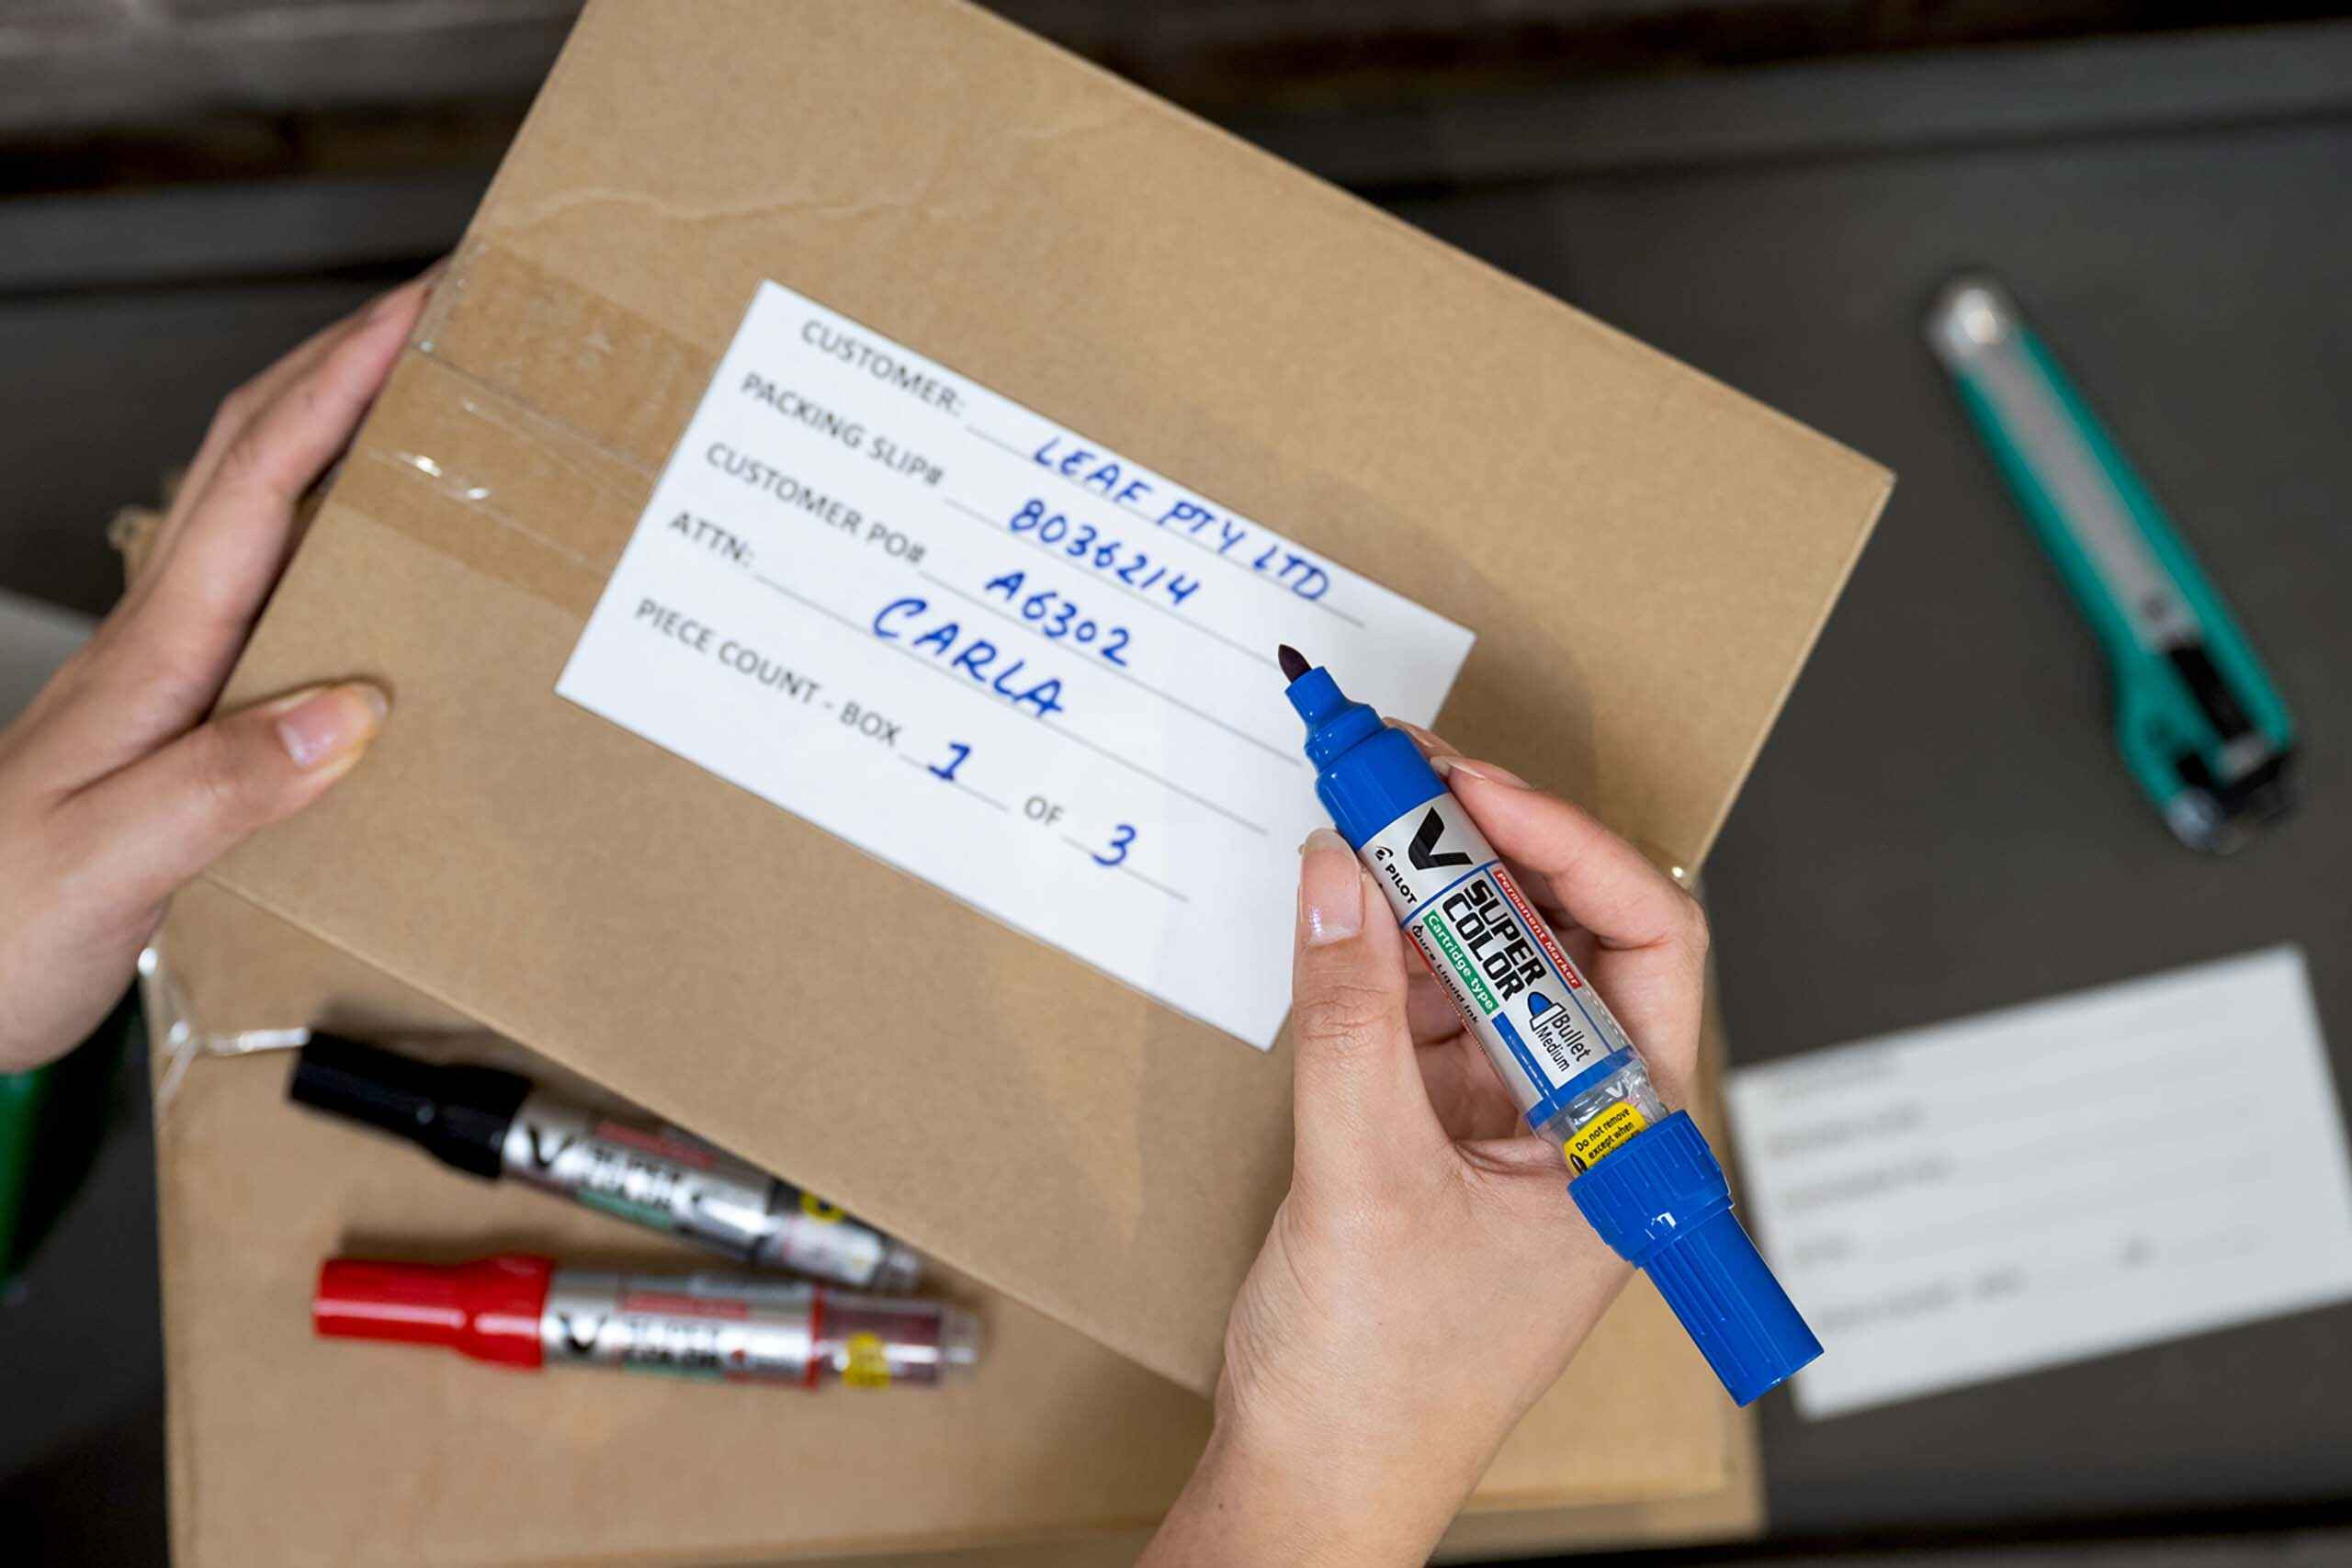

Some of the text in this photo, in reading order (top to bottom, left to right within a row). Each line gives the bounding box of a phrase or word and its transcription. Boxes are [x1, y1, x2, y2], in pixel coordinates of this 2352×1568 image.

[740, 371, 1200, 605] PACKING SLIP# 8036214
[801, 319, 1330, 602] CUSTOMER: LEAF PTY LTD
[705, 441, 1132, 667] CUSTOMER PO# A6302
[668, 510, 1064, 717] ATTN: CARLA
[635, 599, 712, 652] PIECE
[717, 640, 820, 706] COUNT
[840, 701, 902, 748] BOX
[927, 742, 972, 782] 1
[1023, 795, 1064, 827] OF
[1091, 824, 1136, 866] 3
[1385, 863, 1418, 904] PILOT
[1408, 807, 1474, 871] V
[1429, 915, 1472, 976] Cartridge
[1470, 977, 1494, 1010] type
[1442, 892, 1525, 1001] COLOR
[1464, 879, 1547, 986] SUPER
[1496, 873, 1579, 986] Permanent Marker
[1436, 964, 1465, 1002] Liquid
[1464, 1004, 1479, 1024] Ink
[1551, 1013, 1591, 1062] Bullet
[1535, 1026, 1570, 1072] Medium
[1575, 1139, 1589, 1153] Do
[1589, 1124, 1606, 1142] not
[1602, 1108, 1631, 1131] remove
[1588, 1134, 1615, 1159] except
[1613, 1122, 1634, 1139] when
